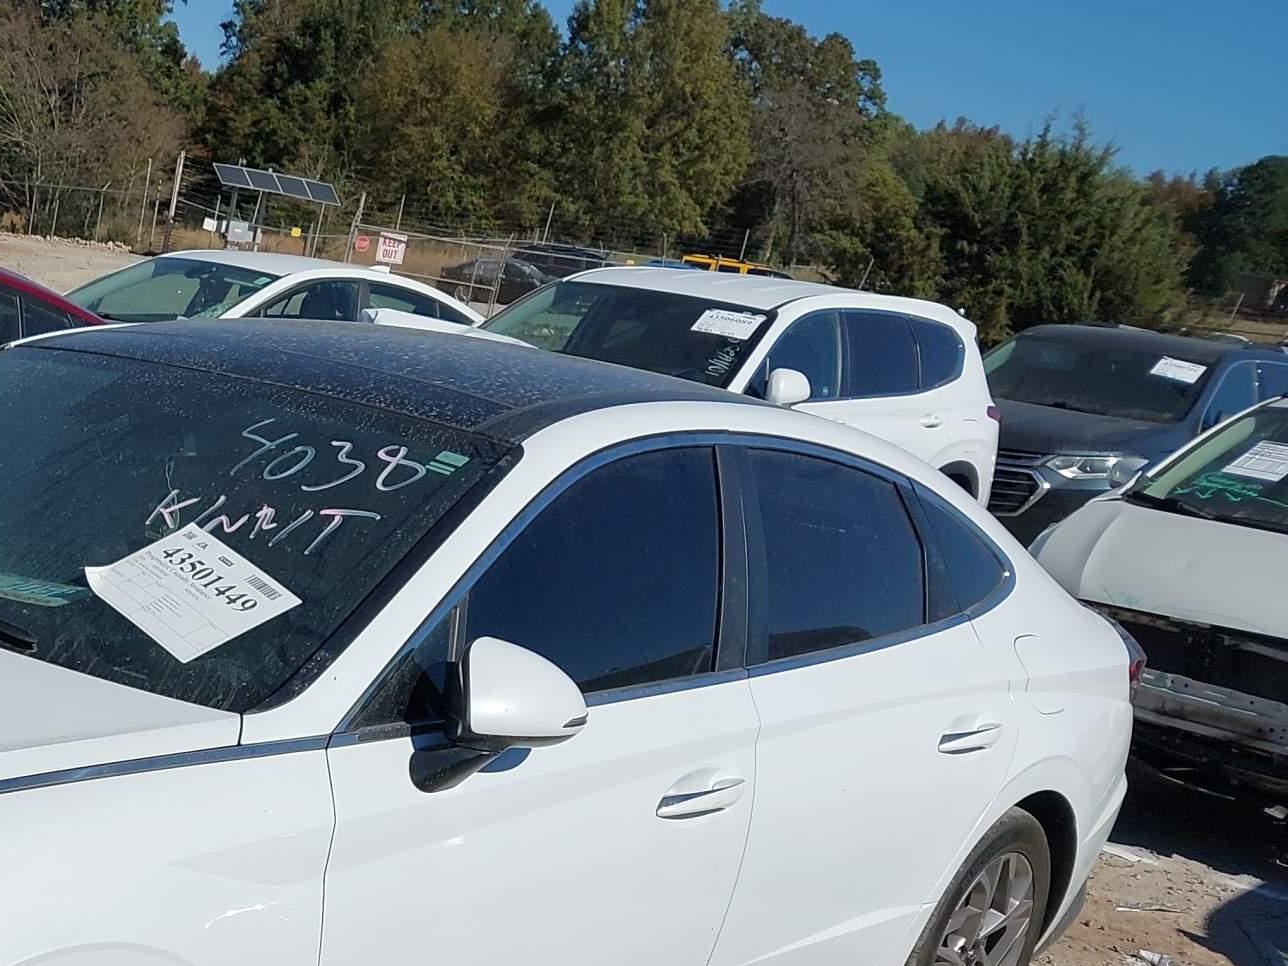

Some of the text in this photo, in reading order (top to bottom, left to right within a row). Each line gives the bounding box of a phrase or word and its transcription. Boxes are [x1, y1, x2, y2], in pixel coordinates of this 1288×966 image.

[382, 236, 400, 248] KEEP
[382, 249, 398, 260] OUT
[229, 417, 427, 491] 4038
[162, 547, 258, 613] 43501449
